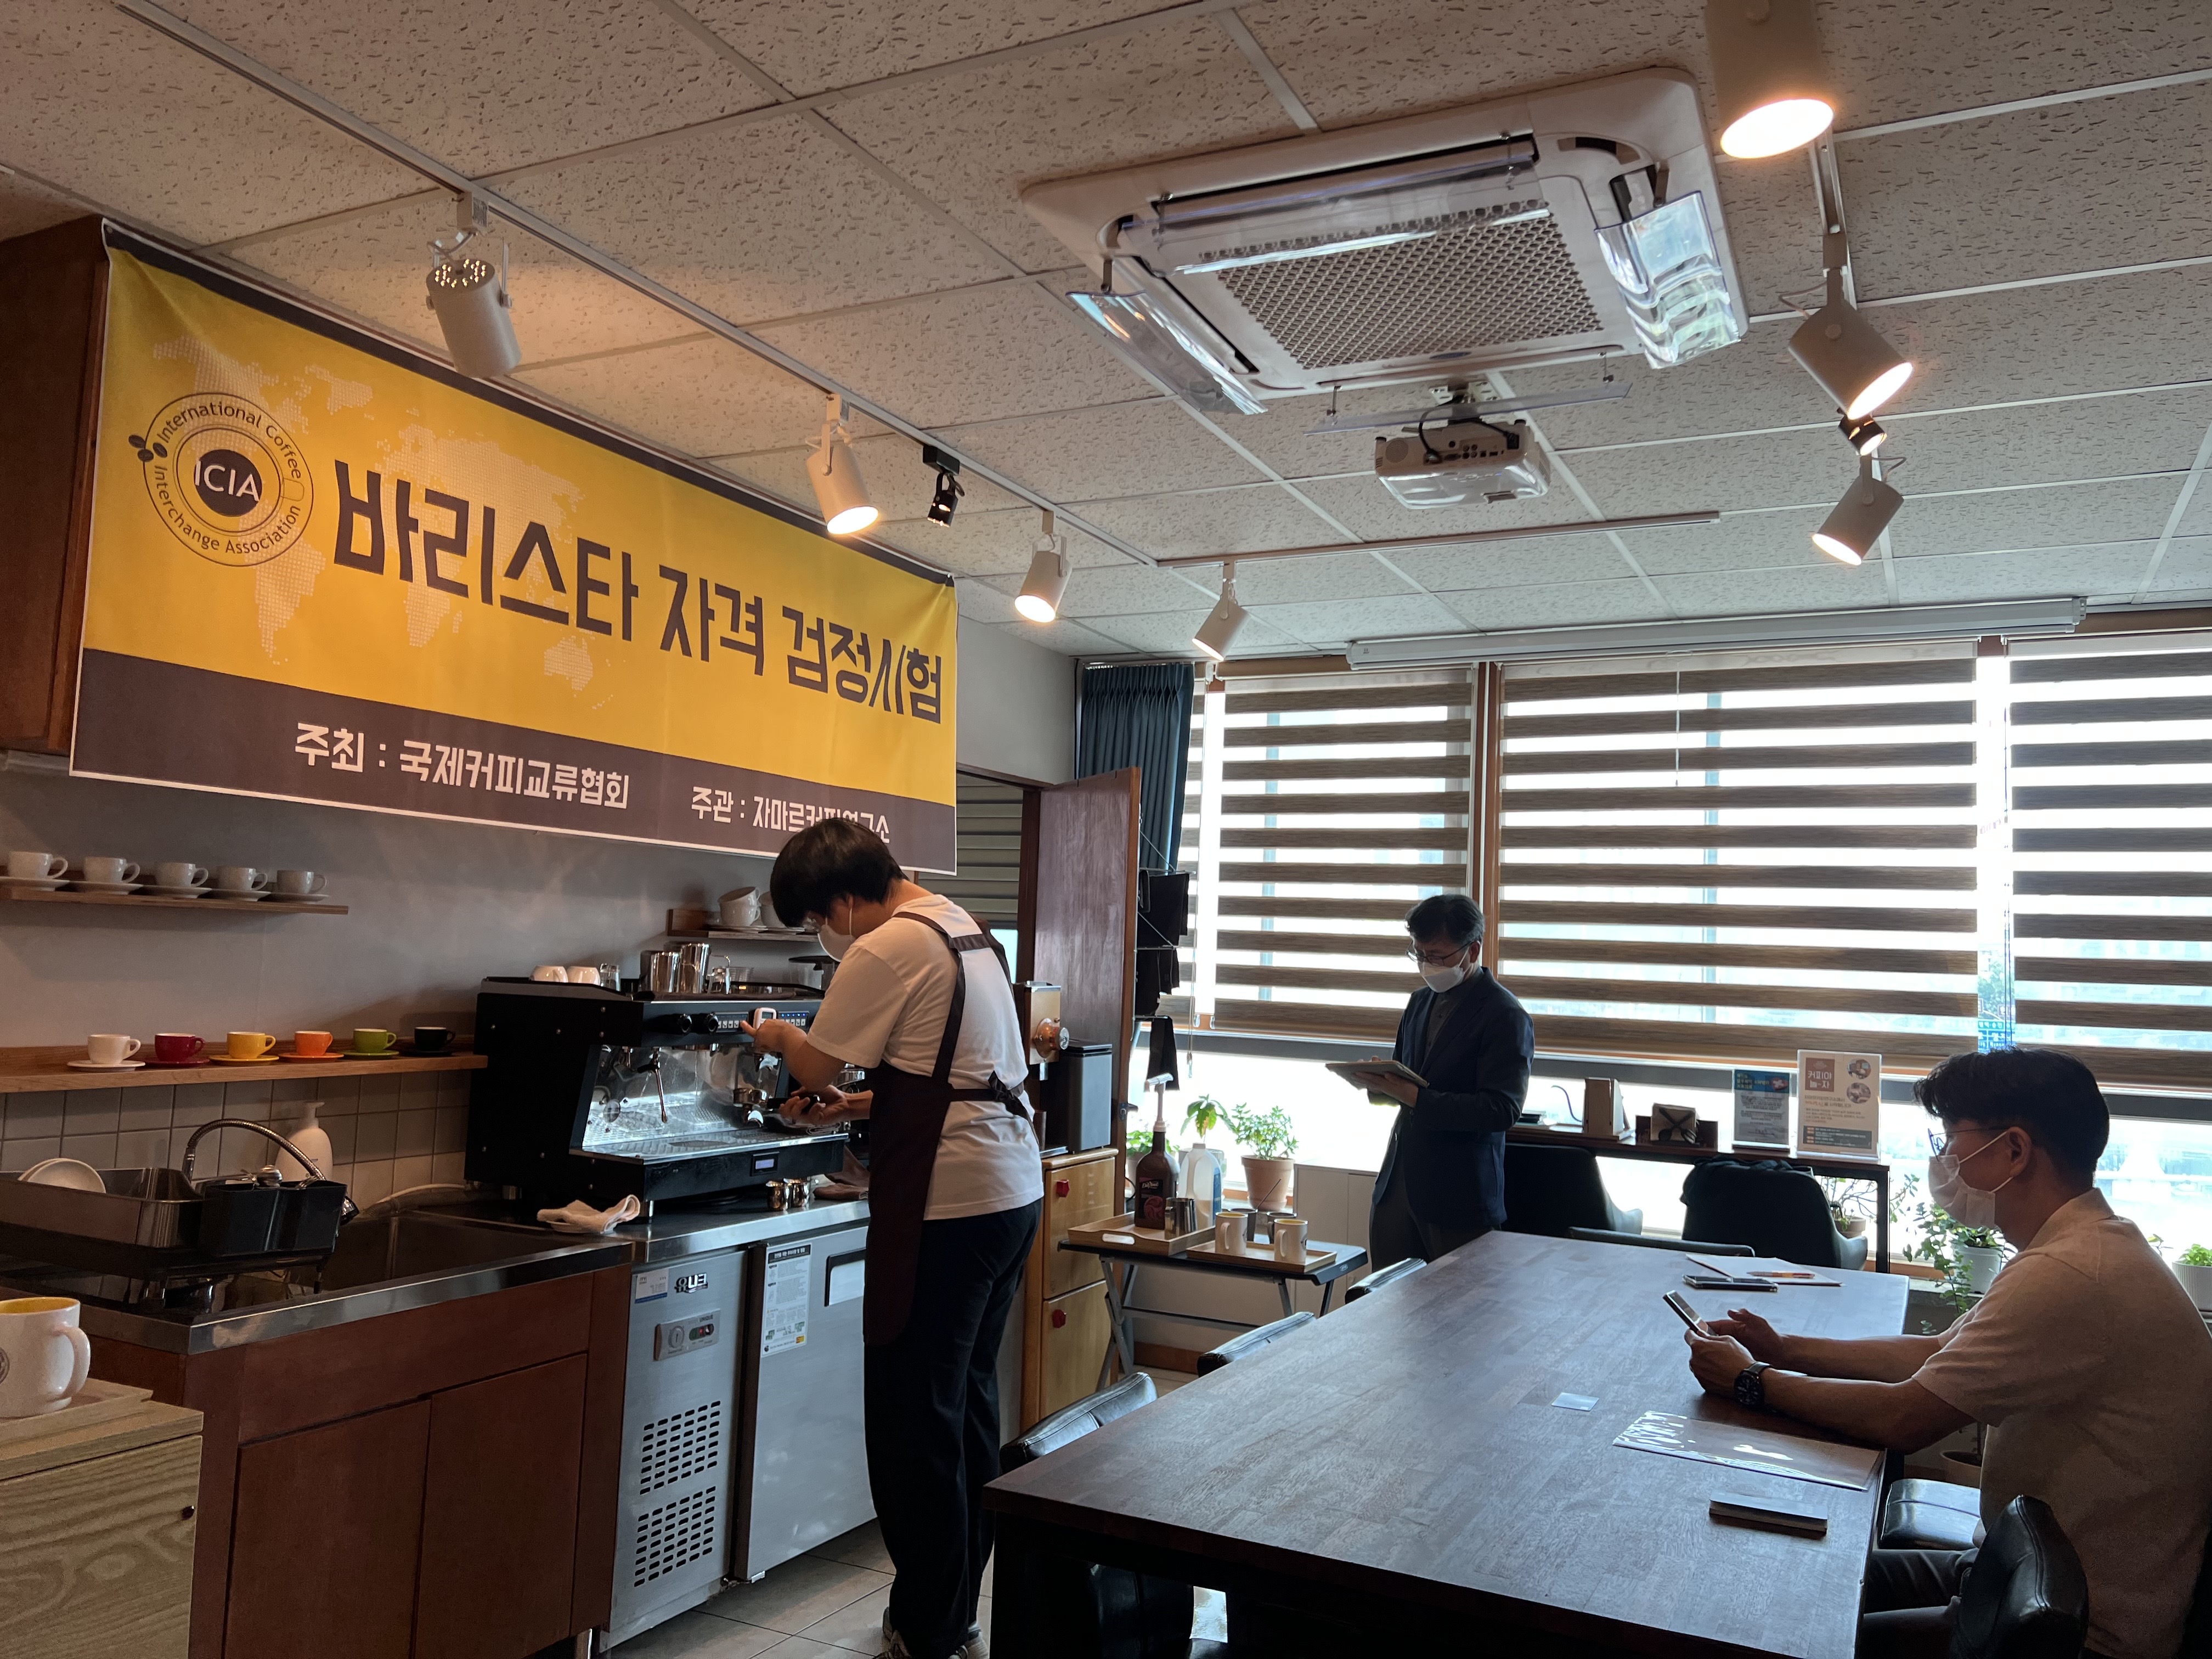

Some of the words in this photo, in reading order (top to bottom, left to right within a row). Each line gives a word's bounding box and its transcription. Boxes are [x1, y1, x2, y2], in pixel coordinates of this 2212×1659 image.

[162, 401, 262, 444] International
[266, 425, 301, 479] Coffee
[194, 460, 259, 502] ICIA
[154, 465, 220, 550] Interchange
[225, 505, 301, 554] Association
[334, 459, 639, 642] 바리스타
[659, 564, 764, 676] 자격
[782, 605, 941, 724] 검정시험
[295, 723, 364, 773] 주최
[400, 740, 629, 809] 국제커피교류협회
[691, 786, 734, 823] 주관
